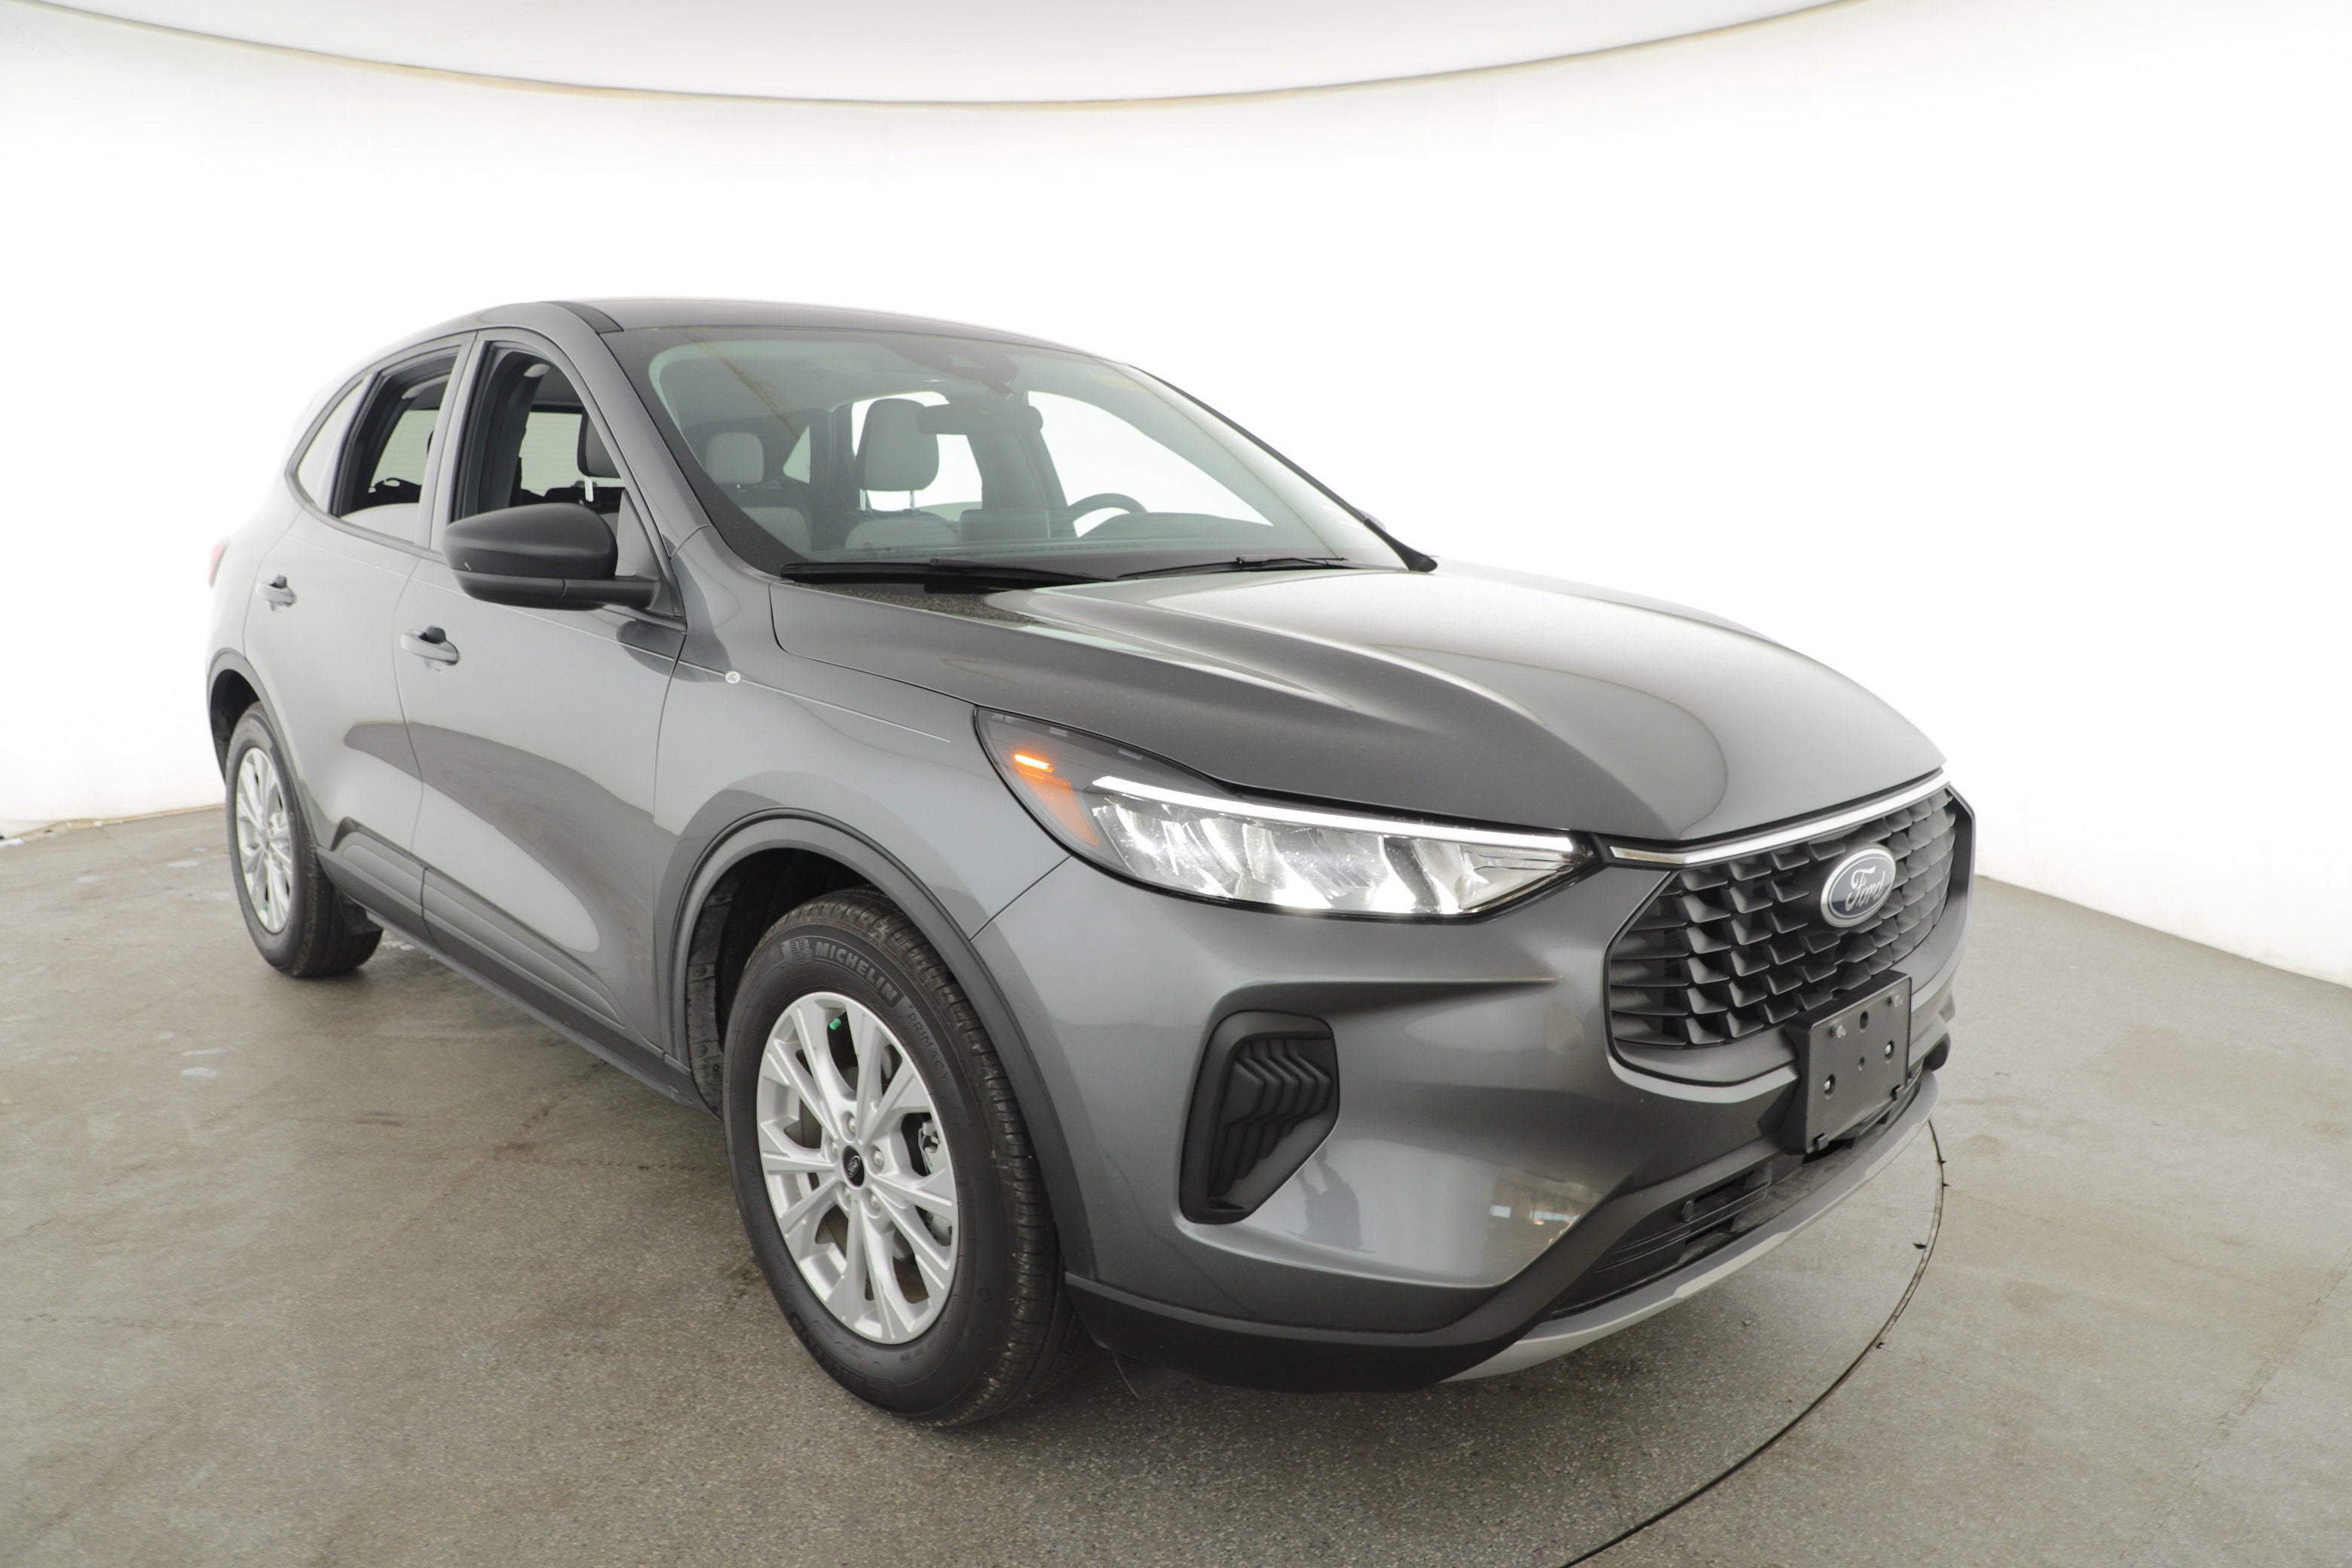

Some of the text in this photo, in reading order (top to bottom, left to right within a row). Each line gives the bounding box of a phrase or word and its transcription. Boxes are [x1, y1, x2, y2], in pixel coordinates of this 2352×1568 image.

[1845, 865, 1885, 911] Ford
[815, 942, 898, 1003] MICHELIN
[908, 1012, 952, 1081] PRIMACY
